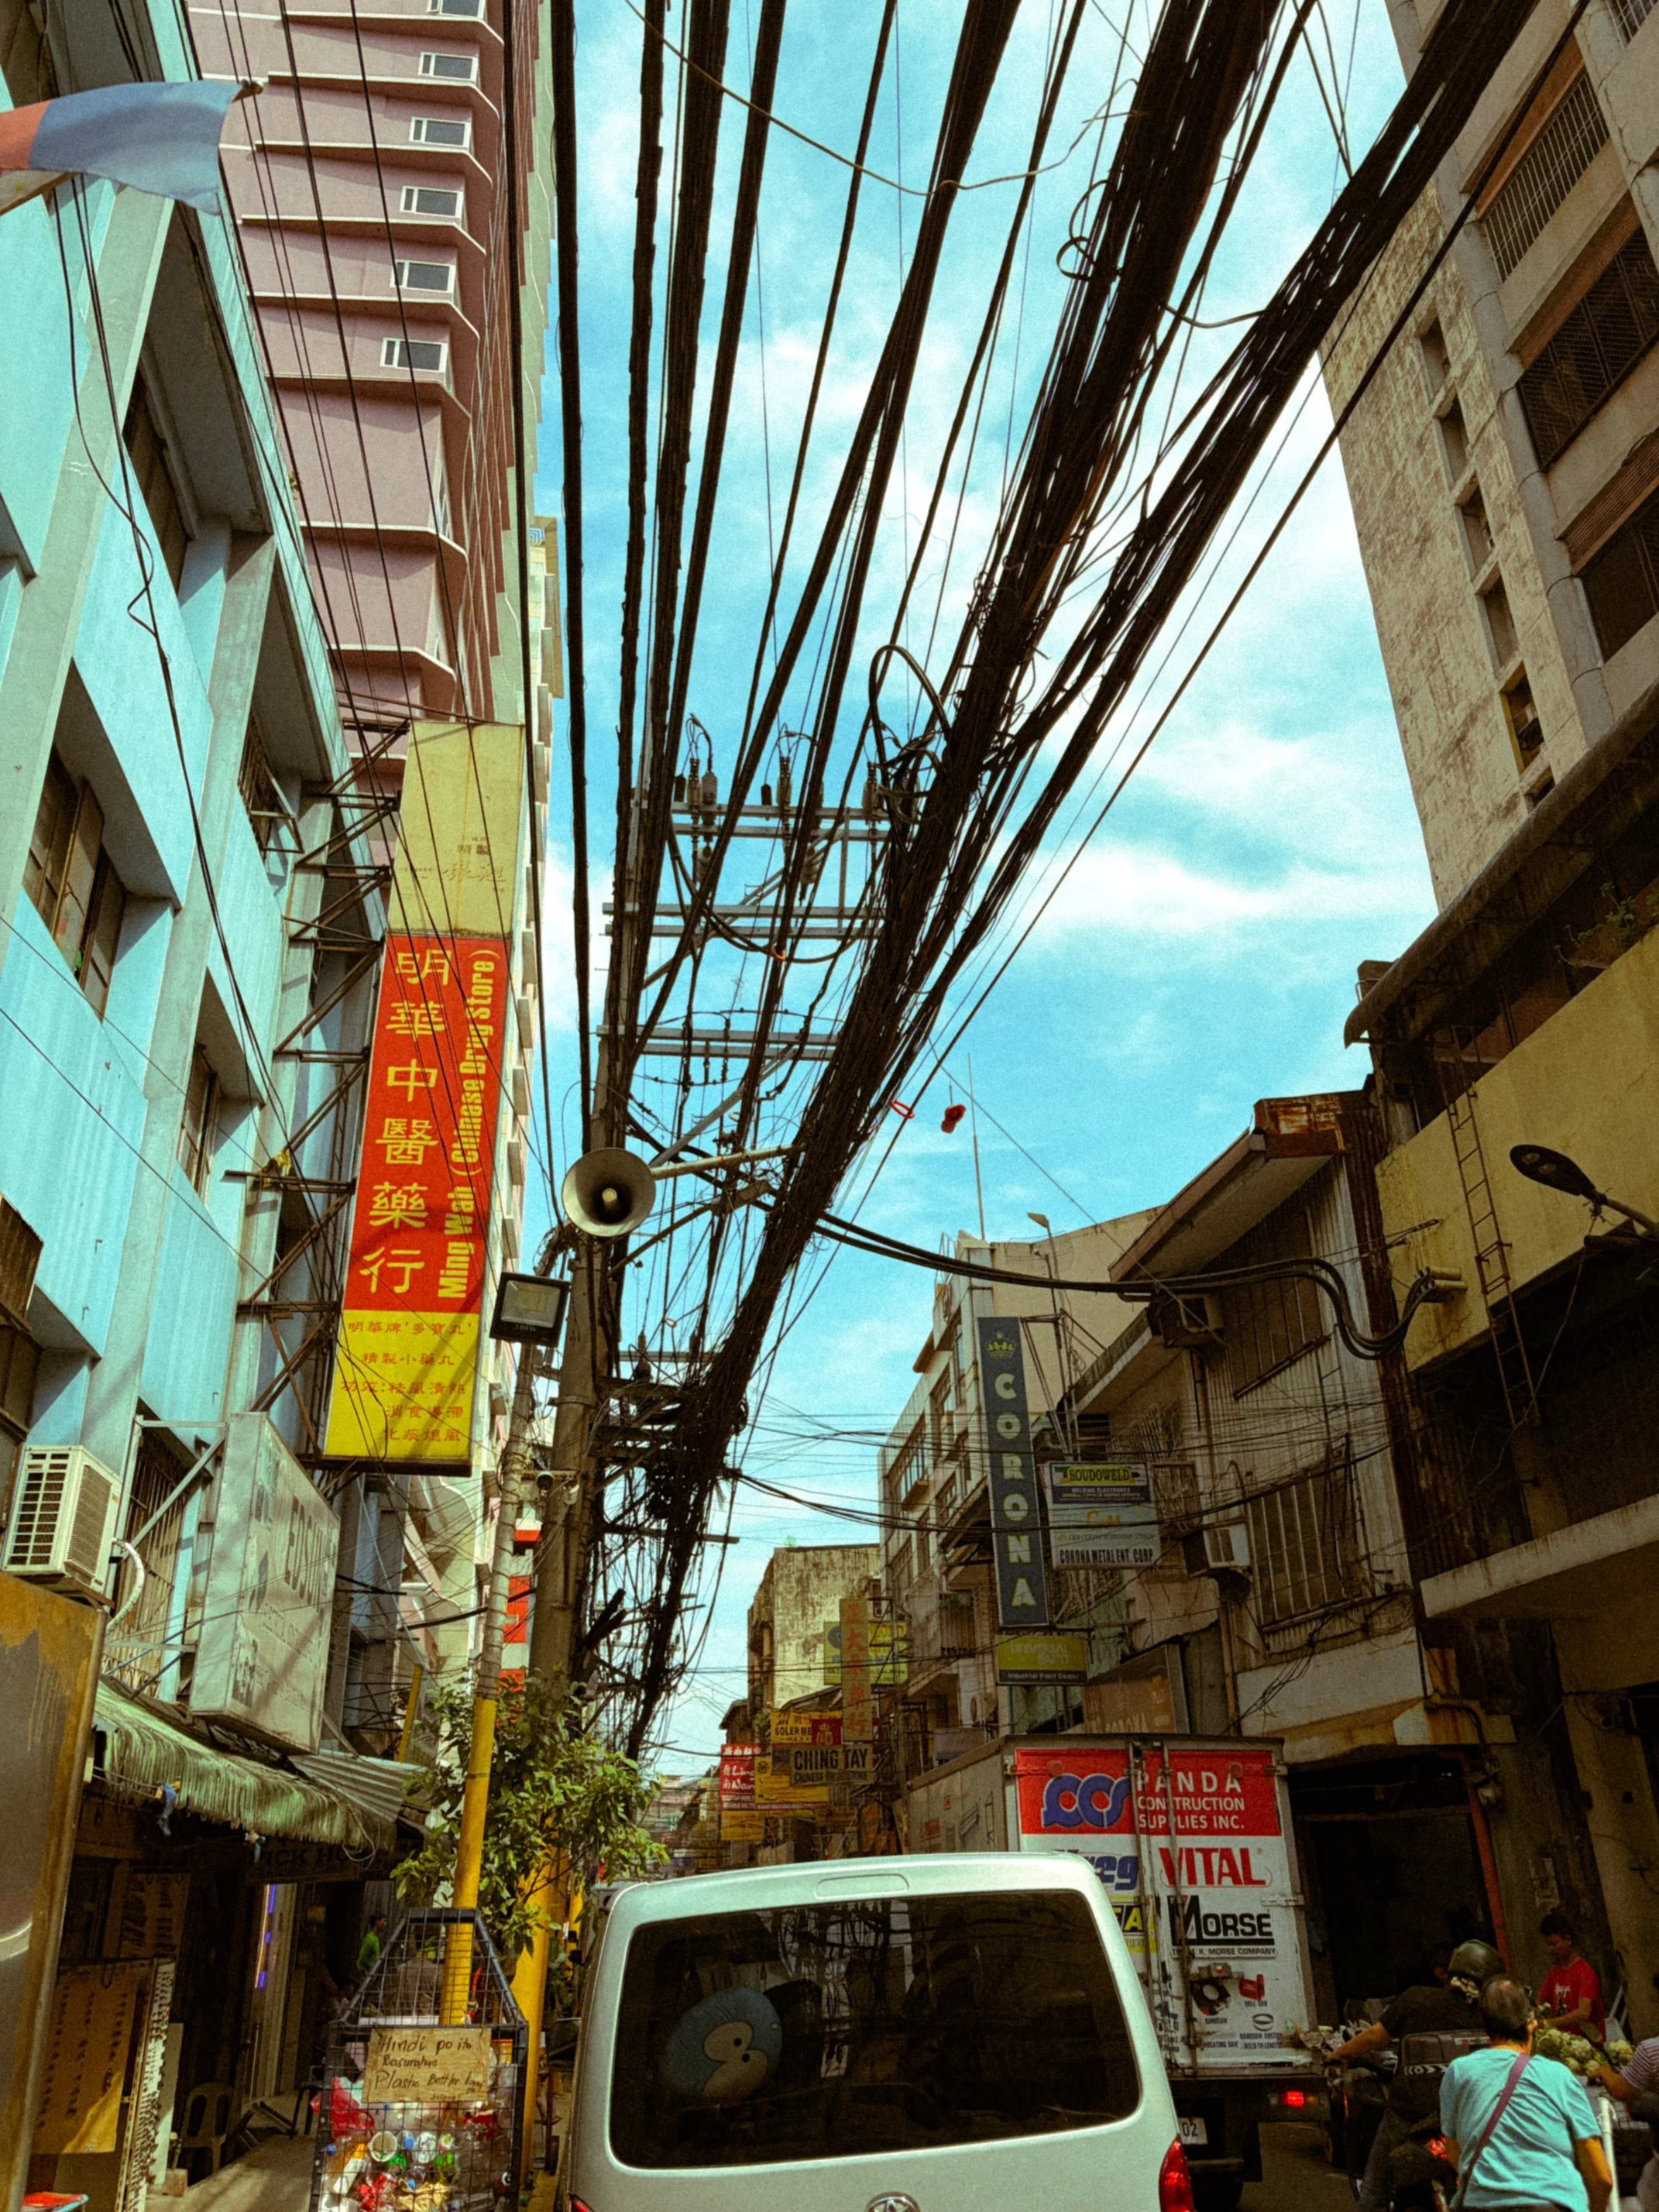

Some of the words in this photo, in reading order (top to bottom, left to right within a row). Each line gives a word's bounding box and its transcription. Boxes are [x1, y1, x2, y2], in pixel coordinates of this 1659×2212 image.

[459, 1024, 494, 1075] Drug
[359, 949, 452, 1295] 明華中醫藥行
[449, 1079, 486, 1176] (Chinese
[444, 1186, 477, 1236] Wah
[438, 1242, 476, 1299] Ming
[994, 1372, 1037, 1609] CORONA
[1069, 1468, 1130, 1482] SOUDOWELD
[1060, 1550, 1090, 1564] CORONA
[1091, 1549, 1115, 1564] METAL
[794, 1750, 839, 1771] CHING
[843, 1748, 868, 1769] TAY
[1135, 1769, 1242, 1794] PANDA
[1137, 1796, 1245, 1812] CONTRUCTION
[1213, 1815, 1245, 1829] INC.
[1159, 1847, 1266, 1885] VITAL
[380, 2034, 427, 2052] Hindi
[436, 2039, 453, 2056] po
